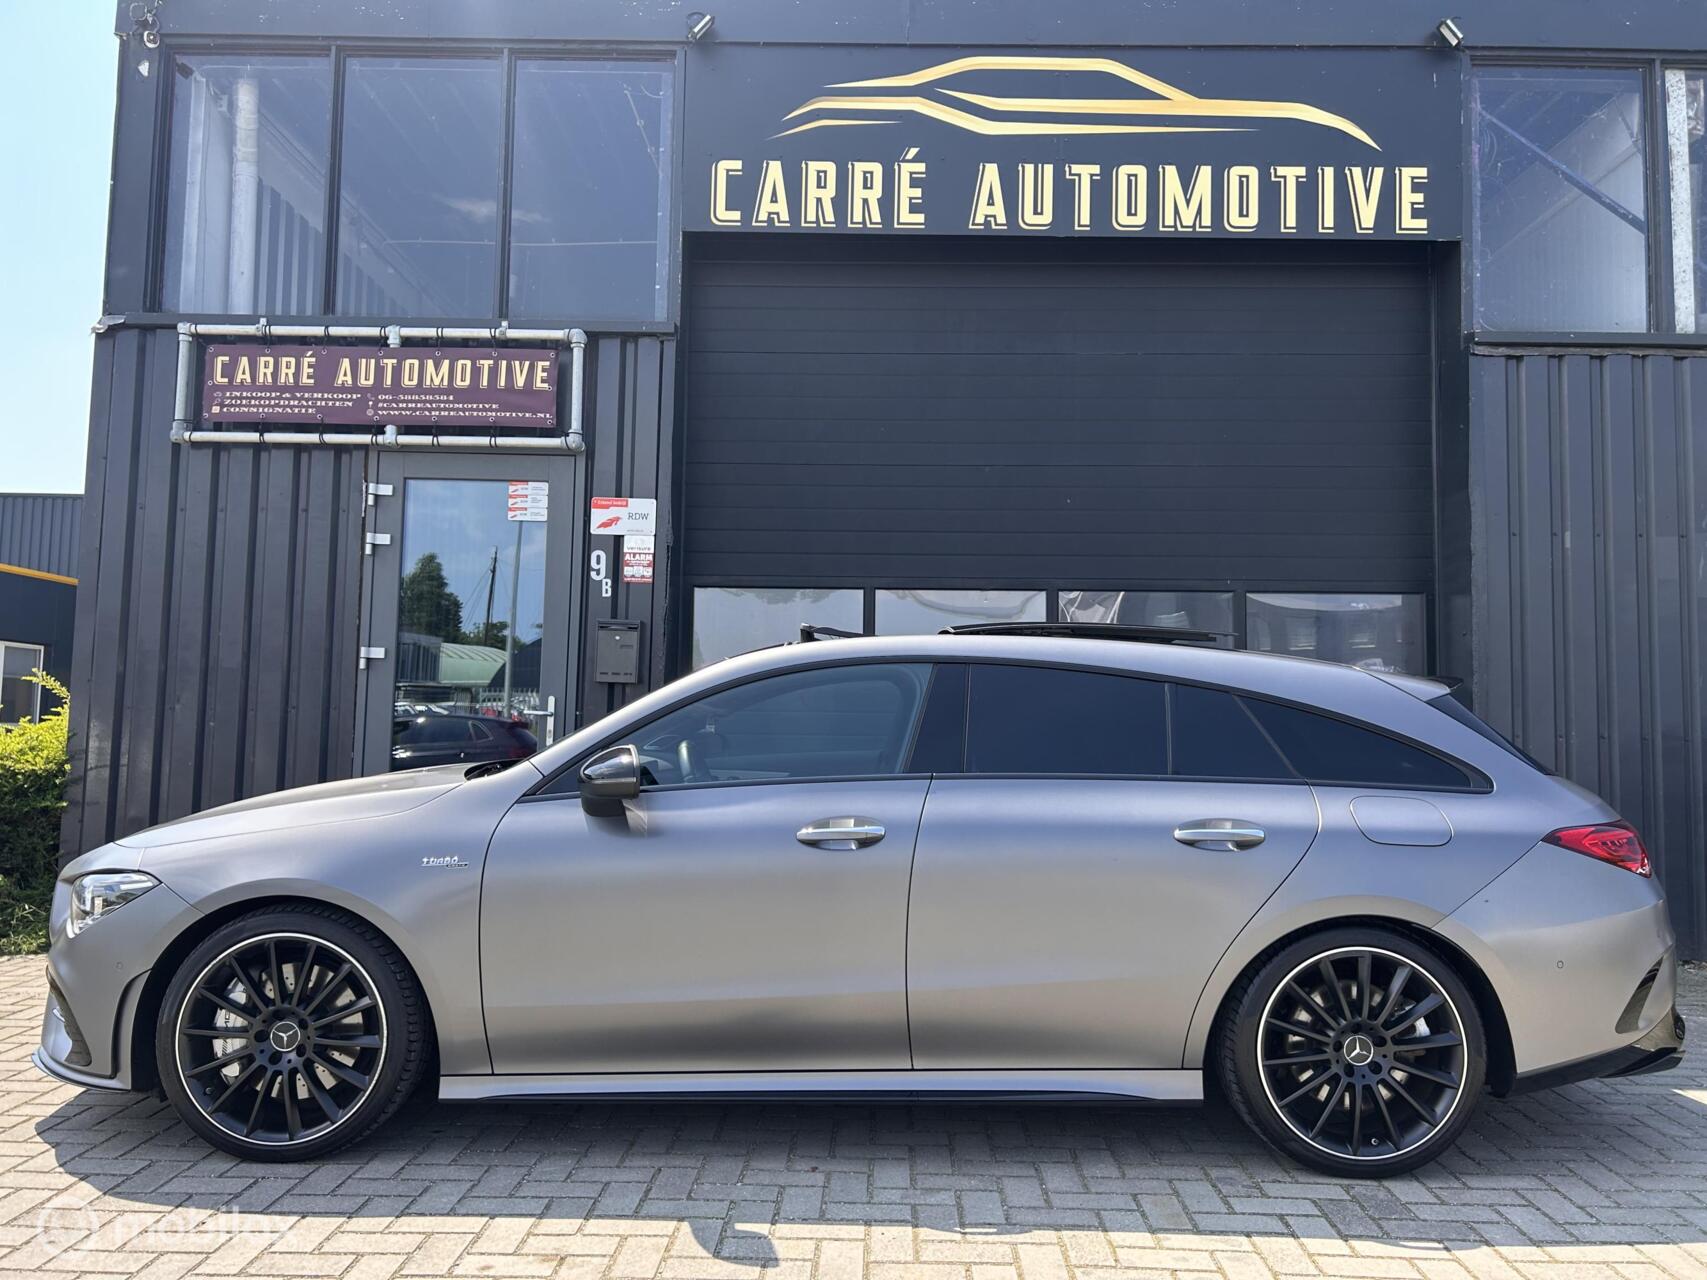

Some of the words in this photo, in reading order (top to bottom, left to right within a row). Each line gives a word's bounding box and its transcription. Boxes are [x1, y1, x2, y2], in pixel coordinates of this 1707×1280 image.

[711, 147, 926, 229] CARRÉ
[968, 161, 1429, 235] AUTOMOTIVE
[213, 351, 317, 386] CARRÉ
[334, 358, 551, 391] AUTOMOTIVE
[223, 399, 353, 407] ZOEKOPDRACHTEN
[222, 406, 317, 414] CONSIGNATIE
[377, 410, 553, 418] WWW.CARREAUTOMOTIVE.NL
[627, 512, 650, 521] RDW
[624, 553, 653, 561] ALARM
[590, 549, 607, 581] 9
[601, 578, 612, 597] B
